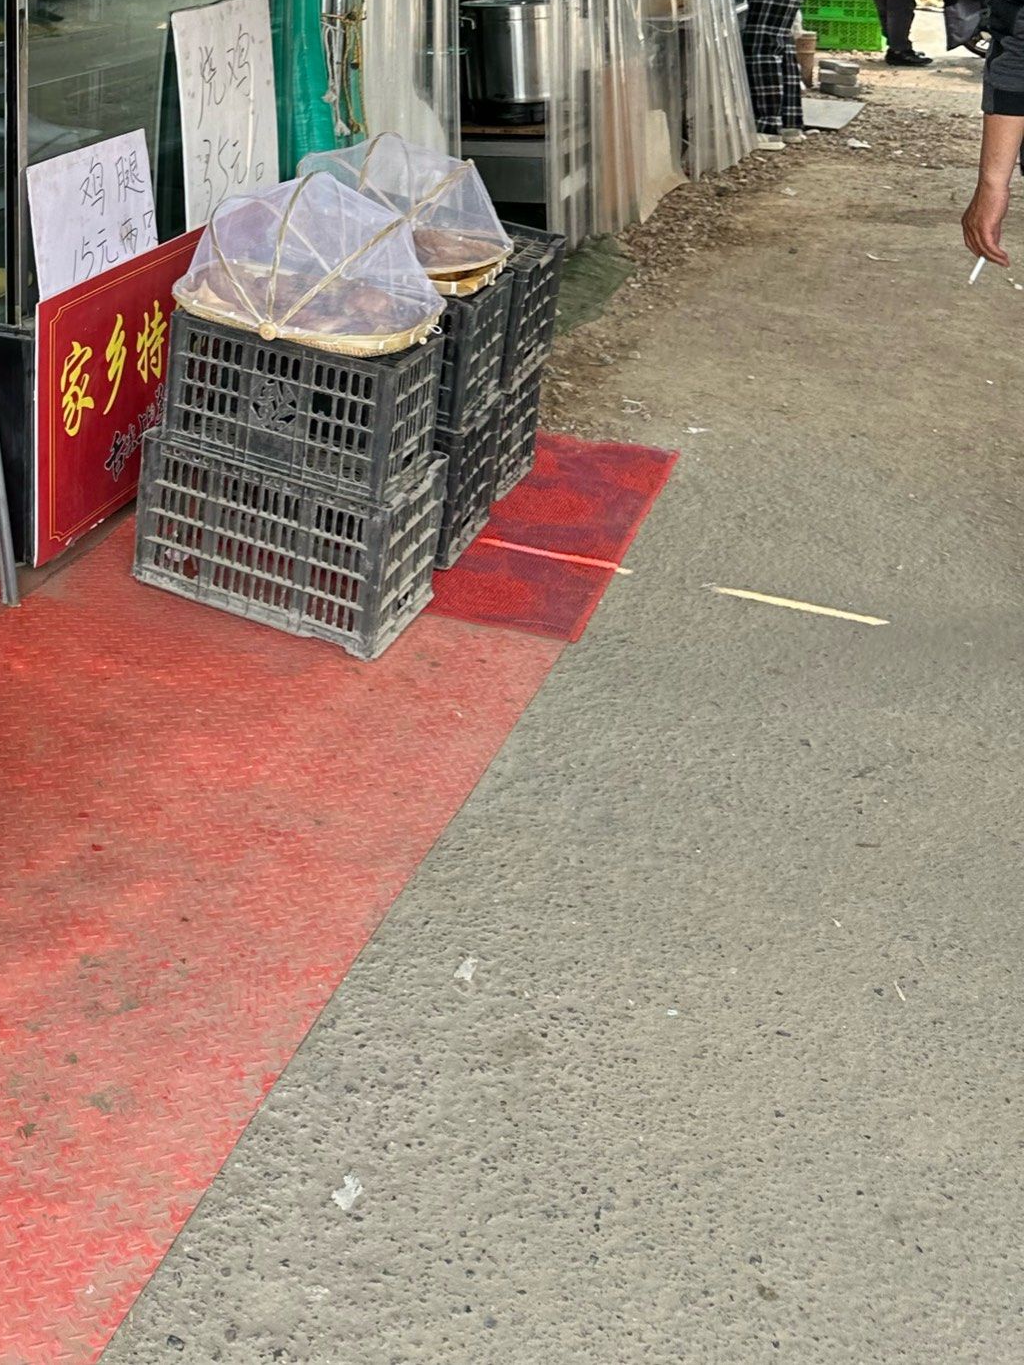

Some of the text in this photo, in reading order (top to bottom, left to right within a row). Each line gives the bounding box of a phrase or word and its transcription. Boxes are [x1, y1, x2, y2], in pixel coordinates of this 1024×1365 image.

[198, 23, 252, 130] 烧鸡
[79, 150, 145, 216] 鸡腿
[60, 299, 168, 437] 家乡特
